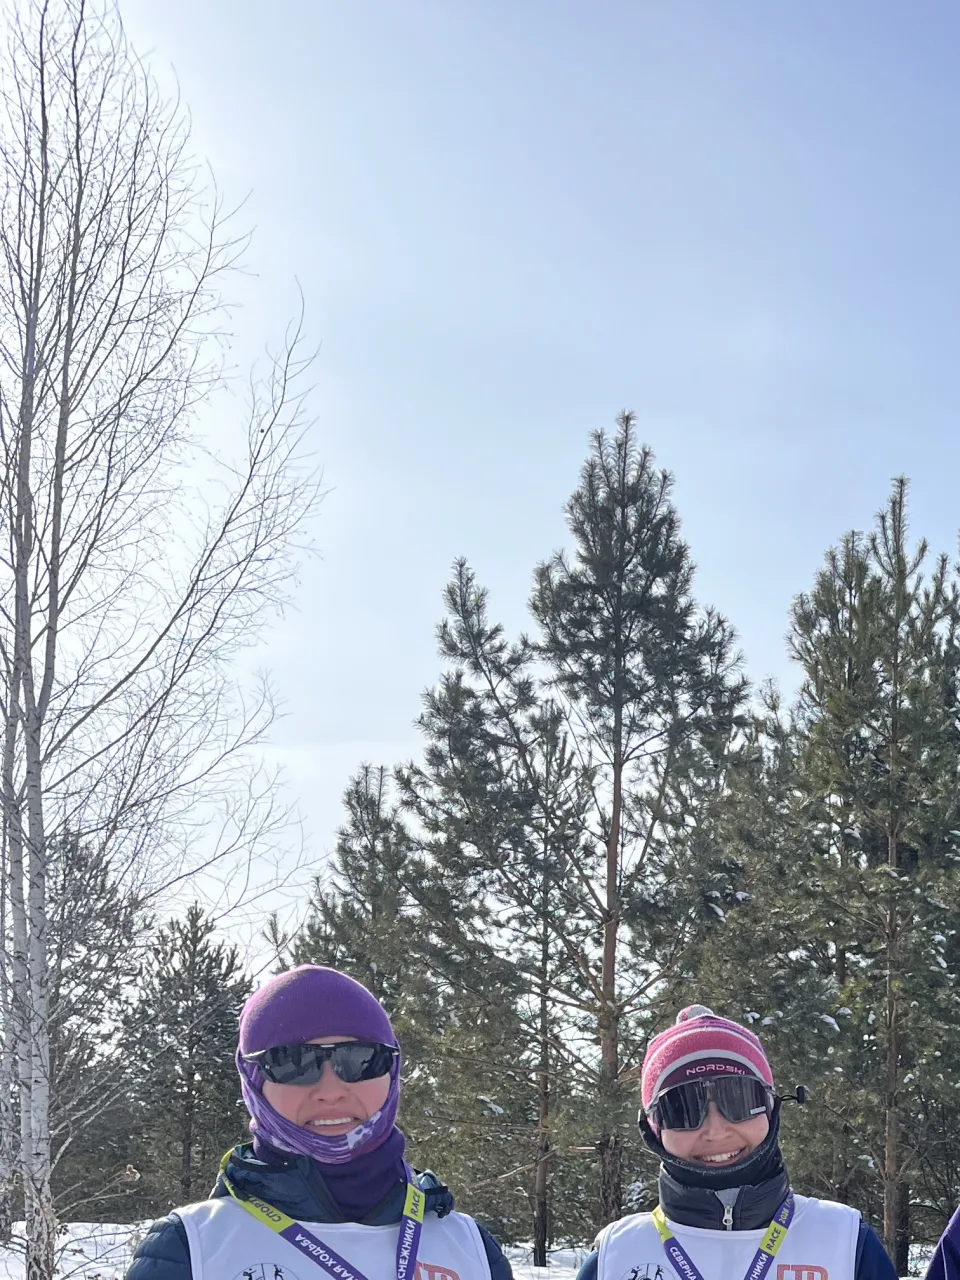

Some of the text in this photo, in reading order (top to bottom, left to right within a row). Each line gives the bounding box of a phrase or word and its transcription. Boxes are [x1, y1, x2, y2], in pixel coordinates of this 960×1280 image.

[410, 1190, 421, 1216] RACE
[295, 1233, 336, 1267] ХОДЬБА
[765, 1227, 782, 1252] RACE
